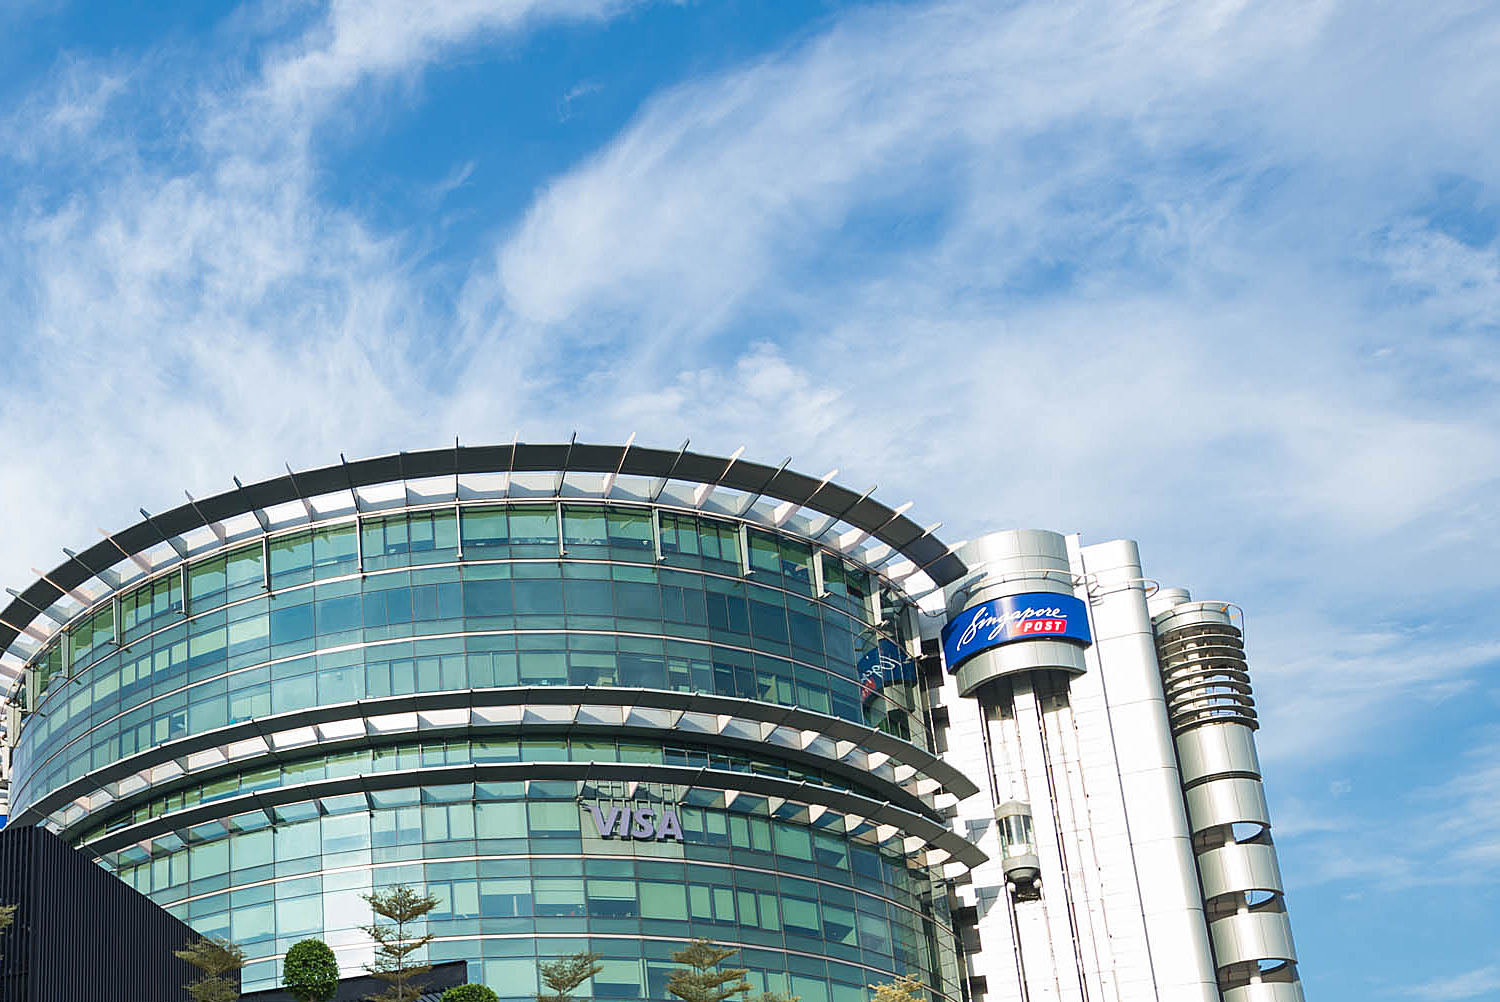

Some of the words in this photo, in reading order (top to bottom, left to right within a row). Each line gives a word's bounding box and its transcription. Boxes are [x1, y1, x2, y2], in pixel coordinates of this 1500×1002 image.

[957, 606, 1067, 652] Singapore
[1023, 621, 1063, 633] POST
[583, 804, 684, 842] VISA
